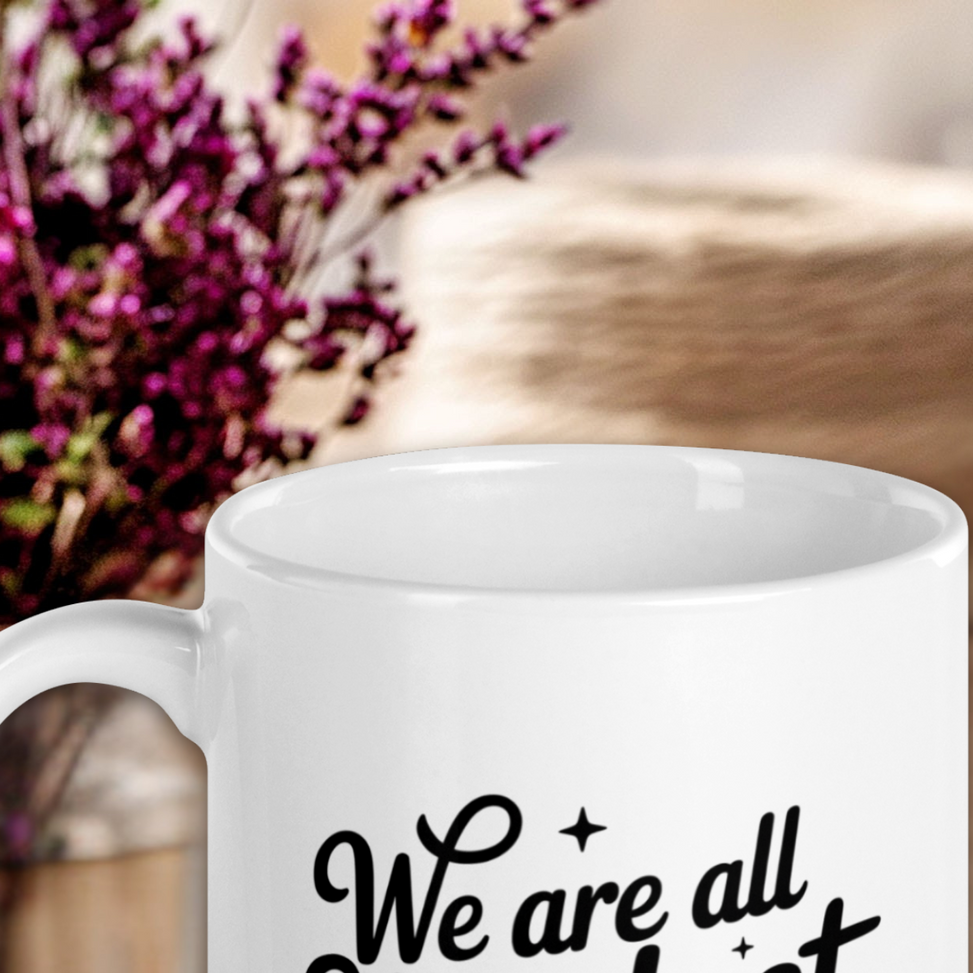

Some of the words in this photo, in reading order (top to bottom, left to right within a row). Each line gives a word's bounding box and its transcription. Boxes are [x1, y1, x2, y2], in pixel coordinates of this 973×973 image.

[313, 794, 523, 966] We
[511, 875, 669, 958] are
[691, 805, 808, 929] all
